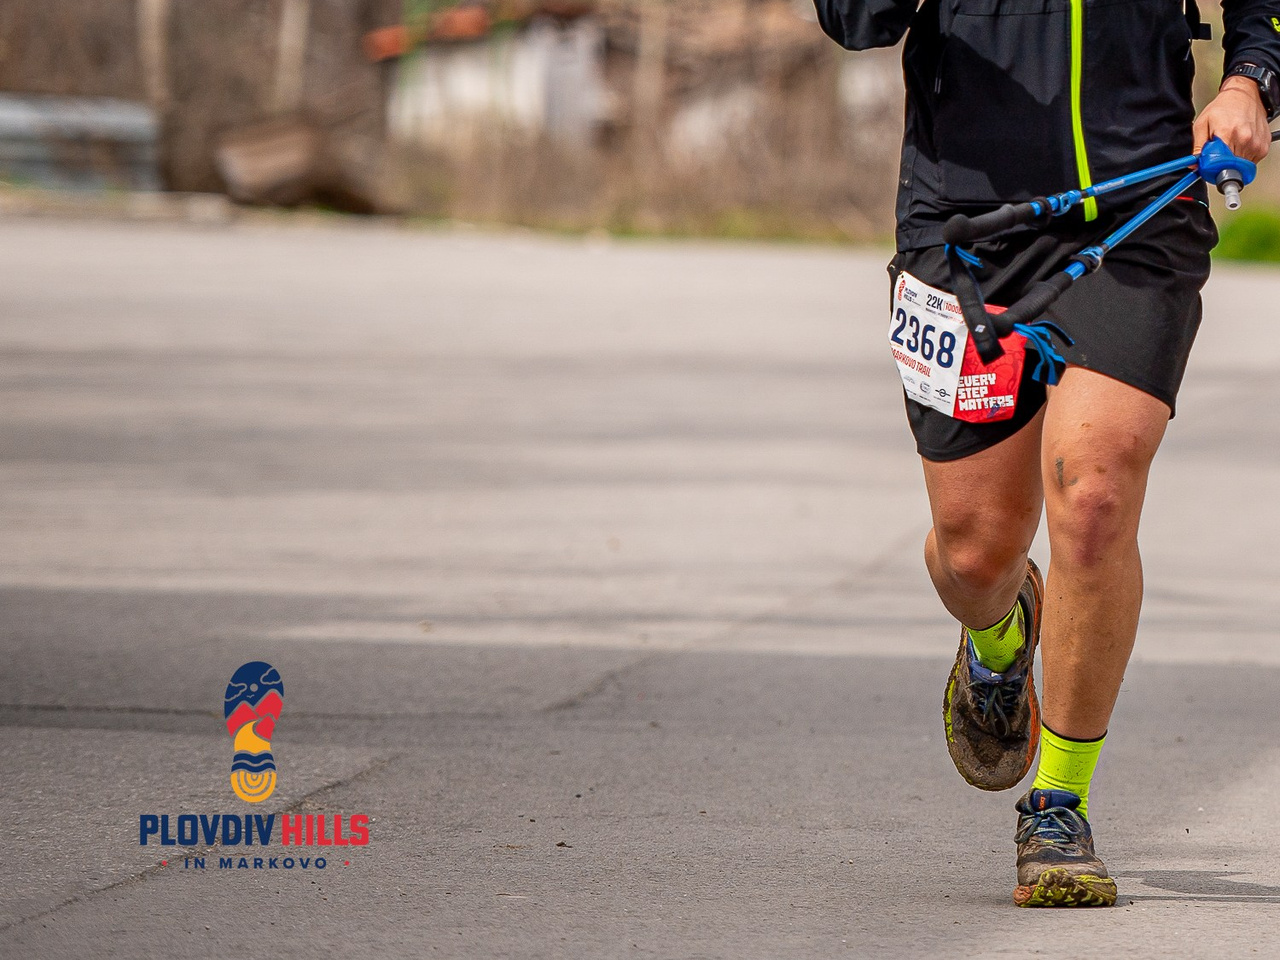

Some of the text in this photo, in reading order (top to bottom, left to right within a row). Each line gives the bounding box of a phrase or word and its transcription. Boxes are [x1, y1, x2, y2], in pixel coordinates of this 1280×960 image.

[926, 293, 943, 310] 22K
[890, 307, 957, 369] 2368
[916, 361, 932, 378] TRAIL
[958, 373, 997, 387] EVERY
[958, 386, 989, 399] STEP
[959, 394, 1015, 411] MATTERS
